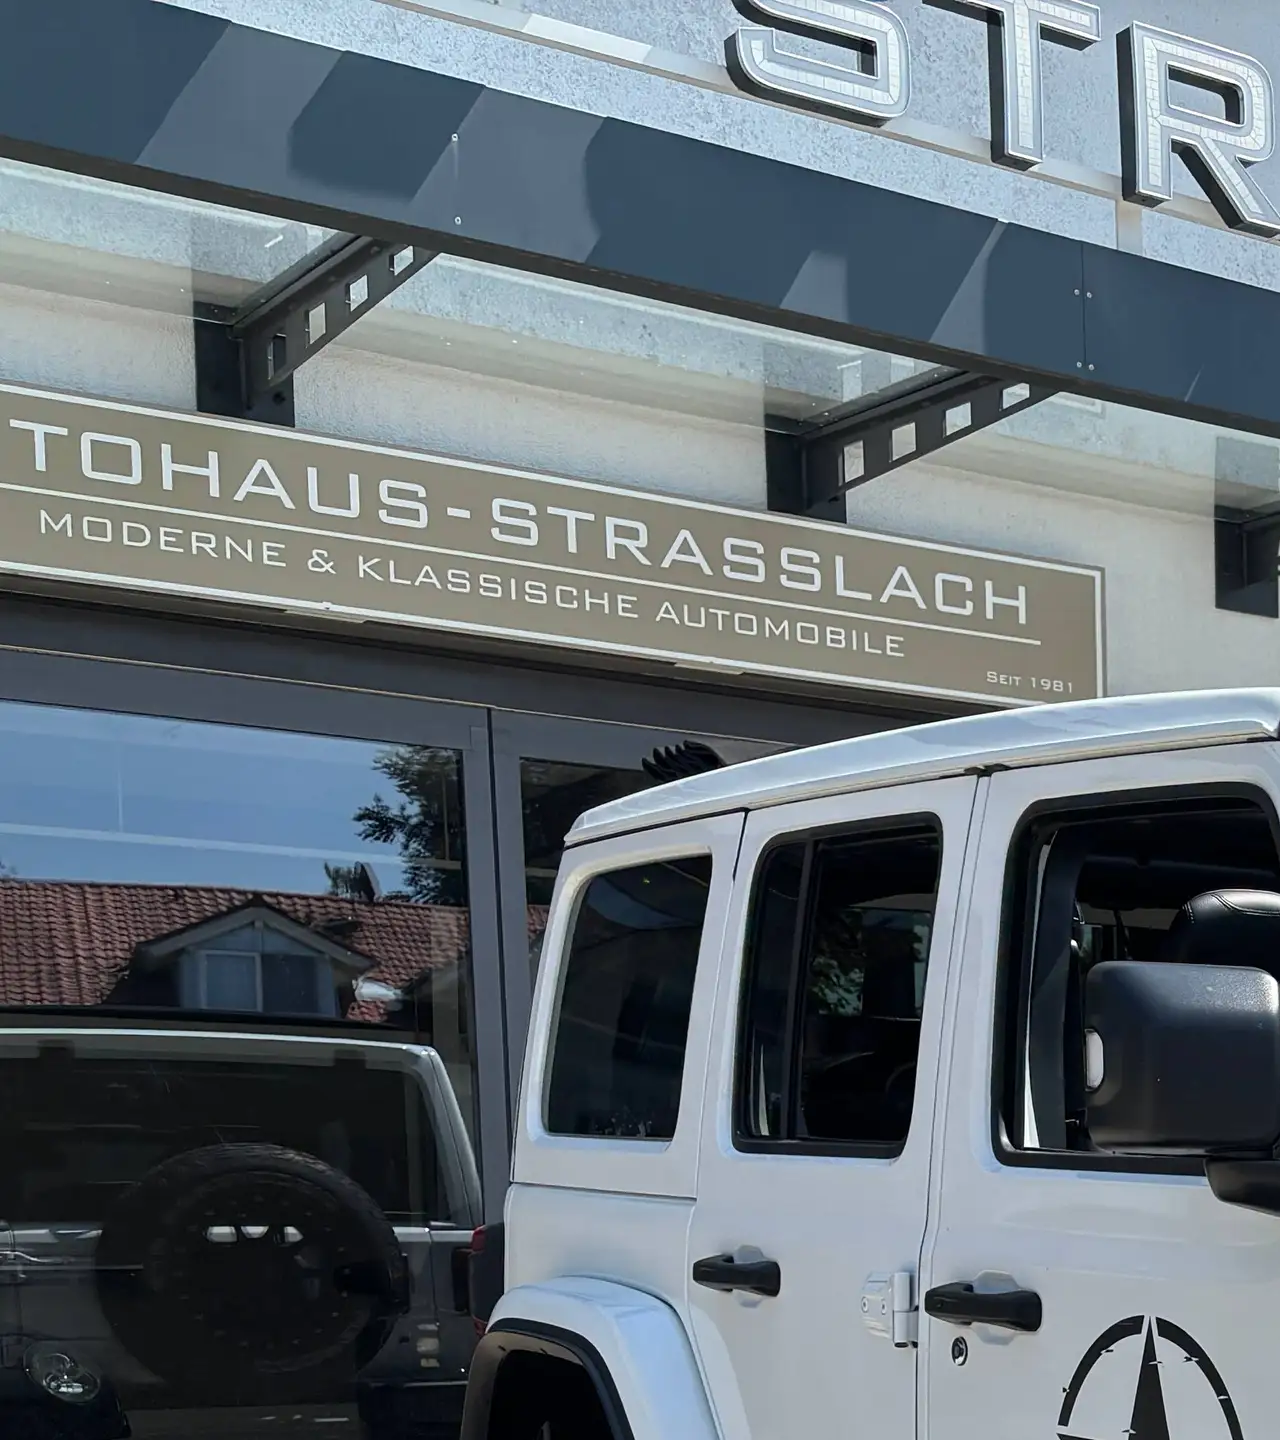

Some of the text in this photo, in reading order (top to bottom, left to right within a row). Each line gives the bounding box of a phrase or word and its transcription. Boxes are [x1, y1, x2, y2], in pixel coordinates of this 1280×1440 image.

[39, 508, 905, 658] MODERNE & KLASSISCHE AUTOMOBILE
[1029, 677, 1073, 693] 1981
